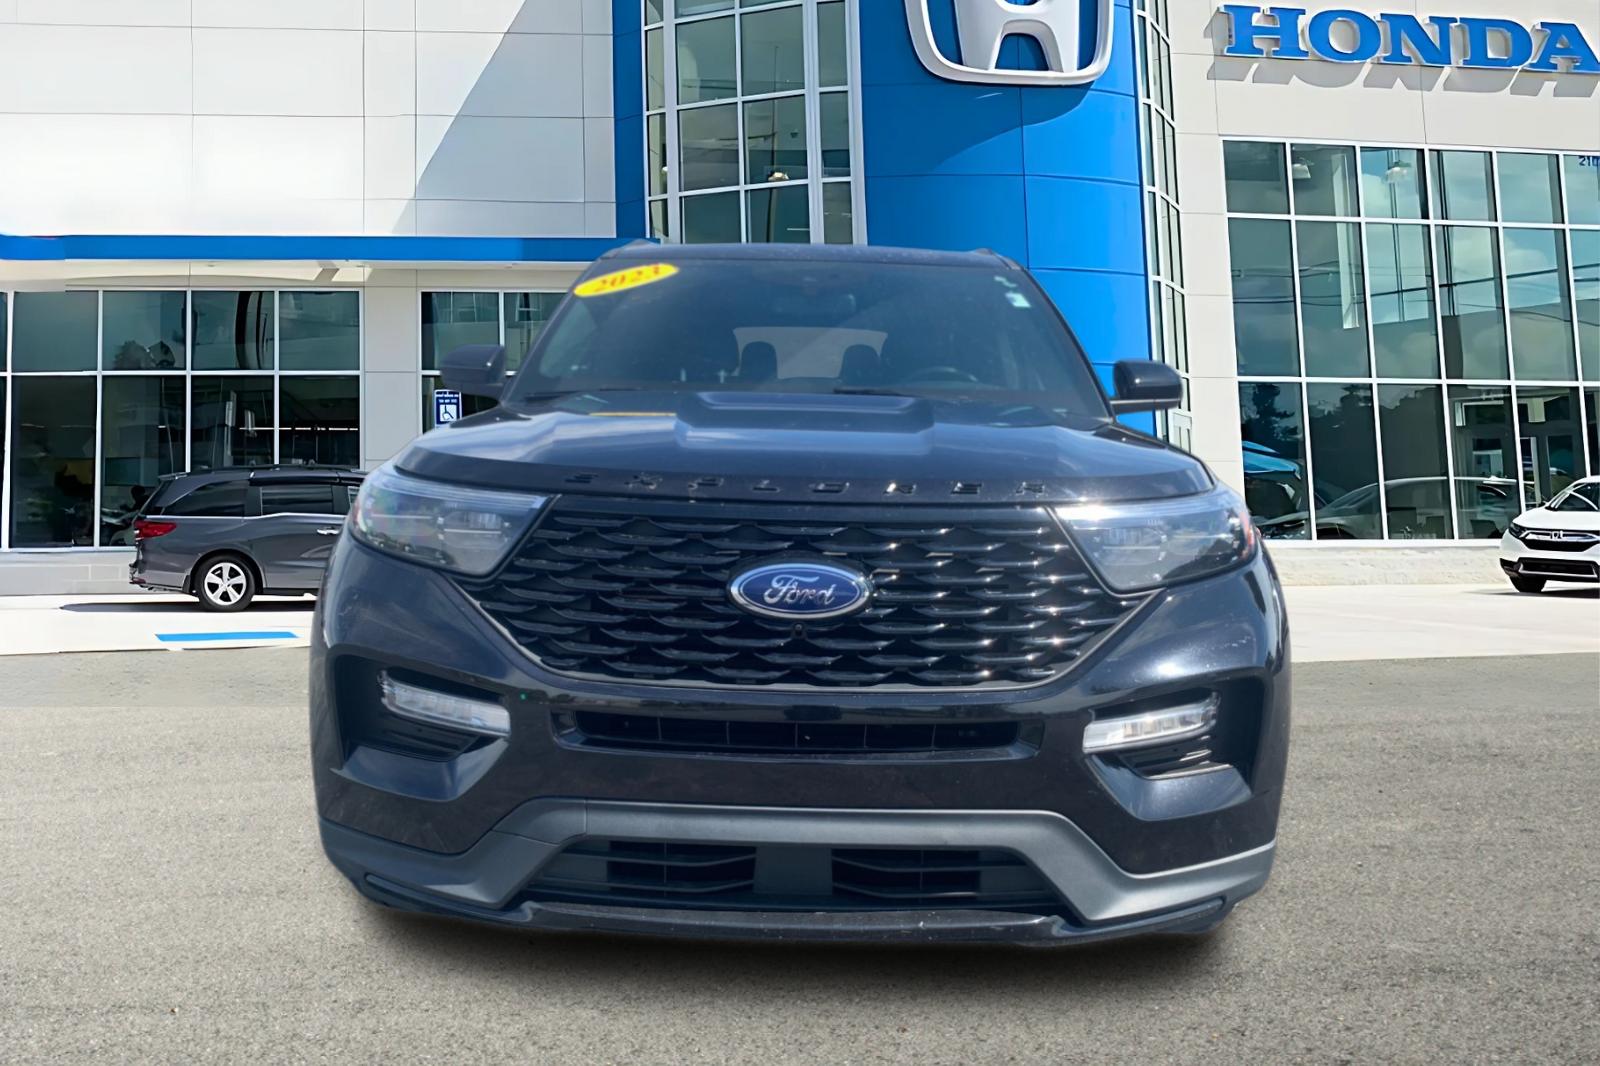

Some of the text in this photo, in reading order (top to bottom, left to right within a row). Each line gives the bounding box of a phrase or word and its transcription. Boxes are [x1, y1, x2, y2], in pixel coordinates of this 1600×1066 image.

[1222, 4, 1600, 73] HONDA
[592, 263, 662, 293] 2023
[563, 471, 1047, 496] EXPLORER
[763, 573, 838, 606] Ford
